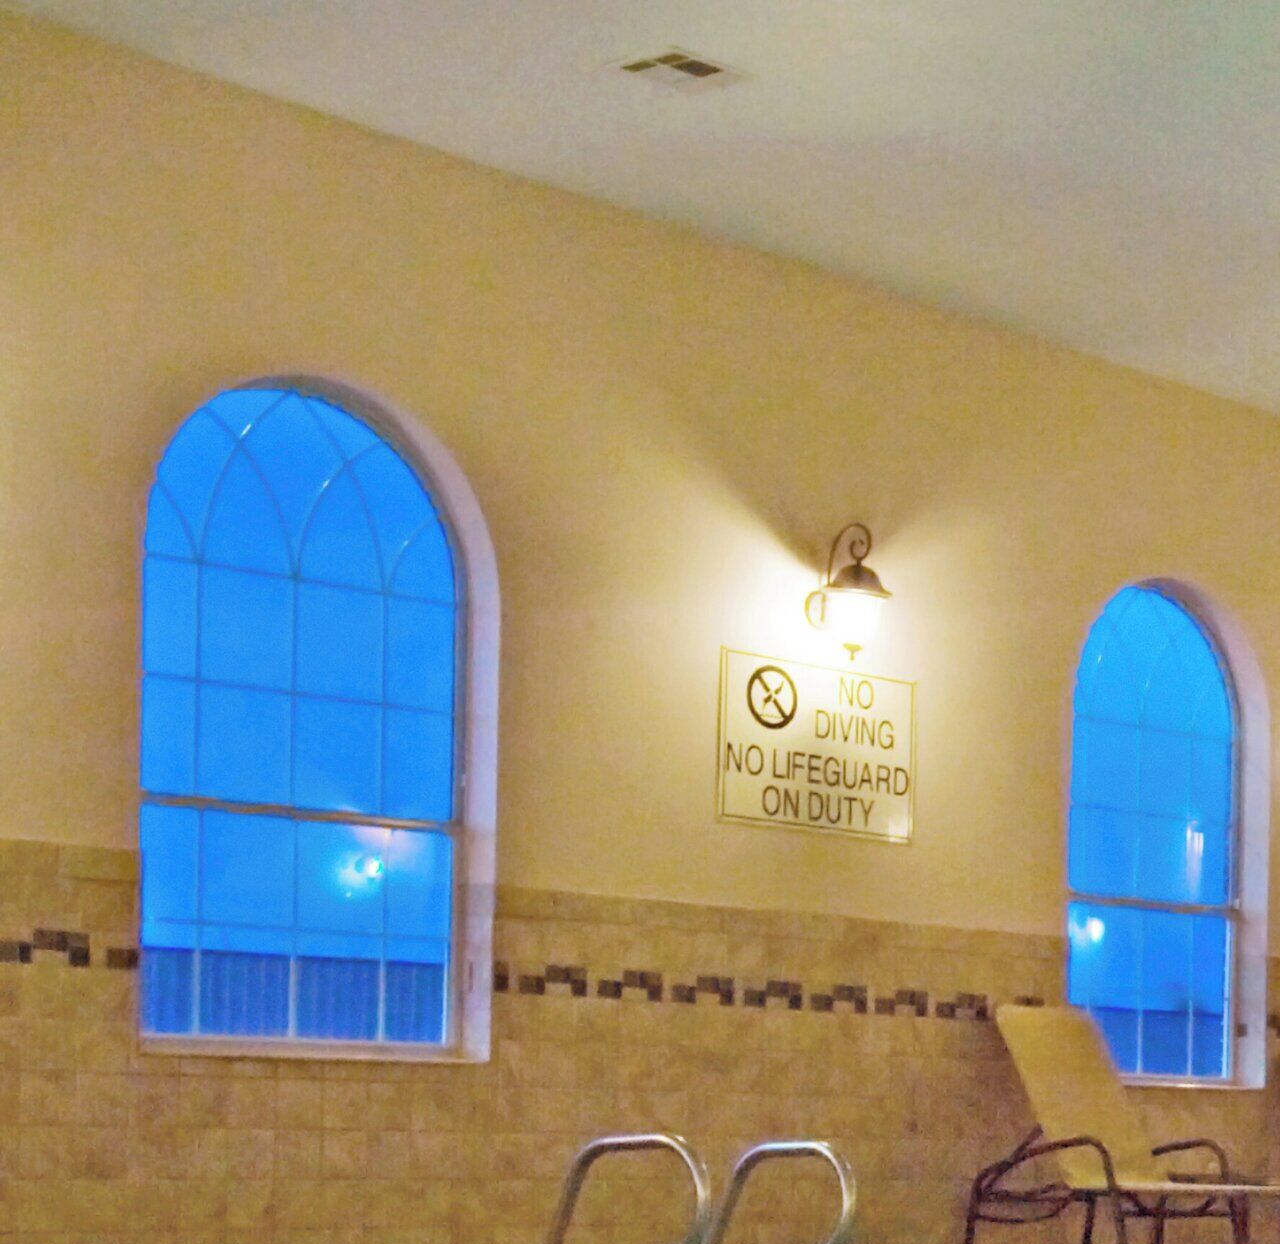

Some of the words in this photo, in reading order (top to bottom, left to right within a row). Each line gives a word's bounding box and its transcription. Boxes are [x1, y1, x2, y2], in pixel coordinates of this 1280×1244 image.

[839, 676, 875, 710] NO
[814, 709, 895, 750] DIVING
[726, 742, 764, 776] NO
[772, 748, 910, 796] LIFEGUARD
[762, 785, 800, 819] ON
[808, 792, 875, 828] DUTY
